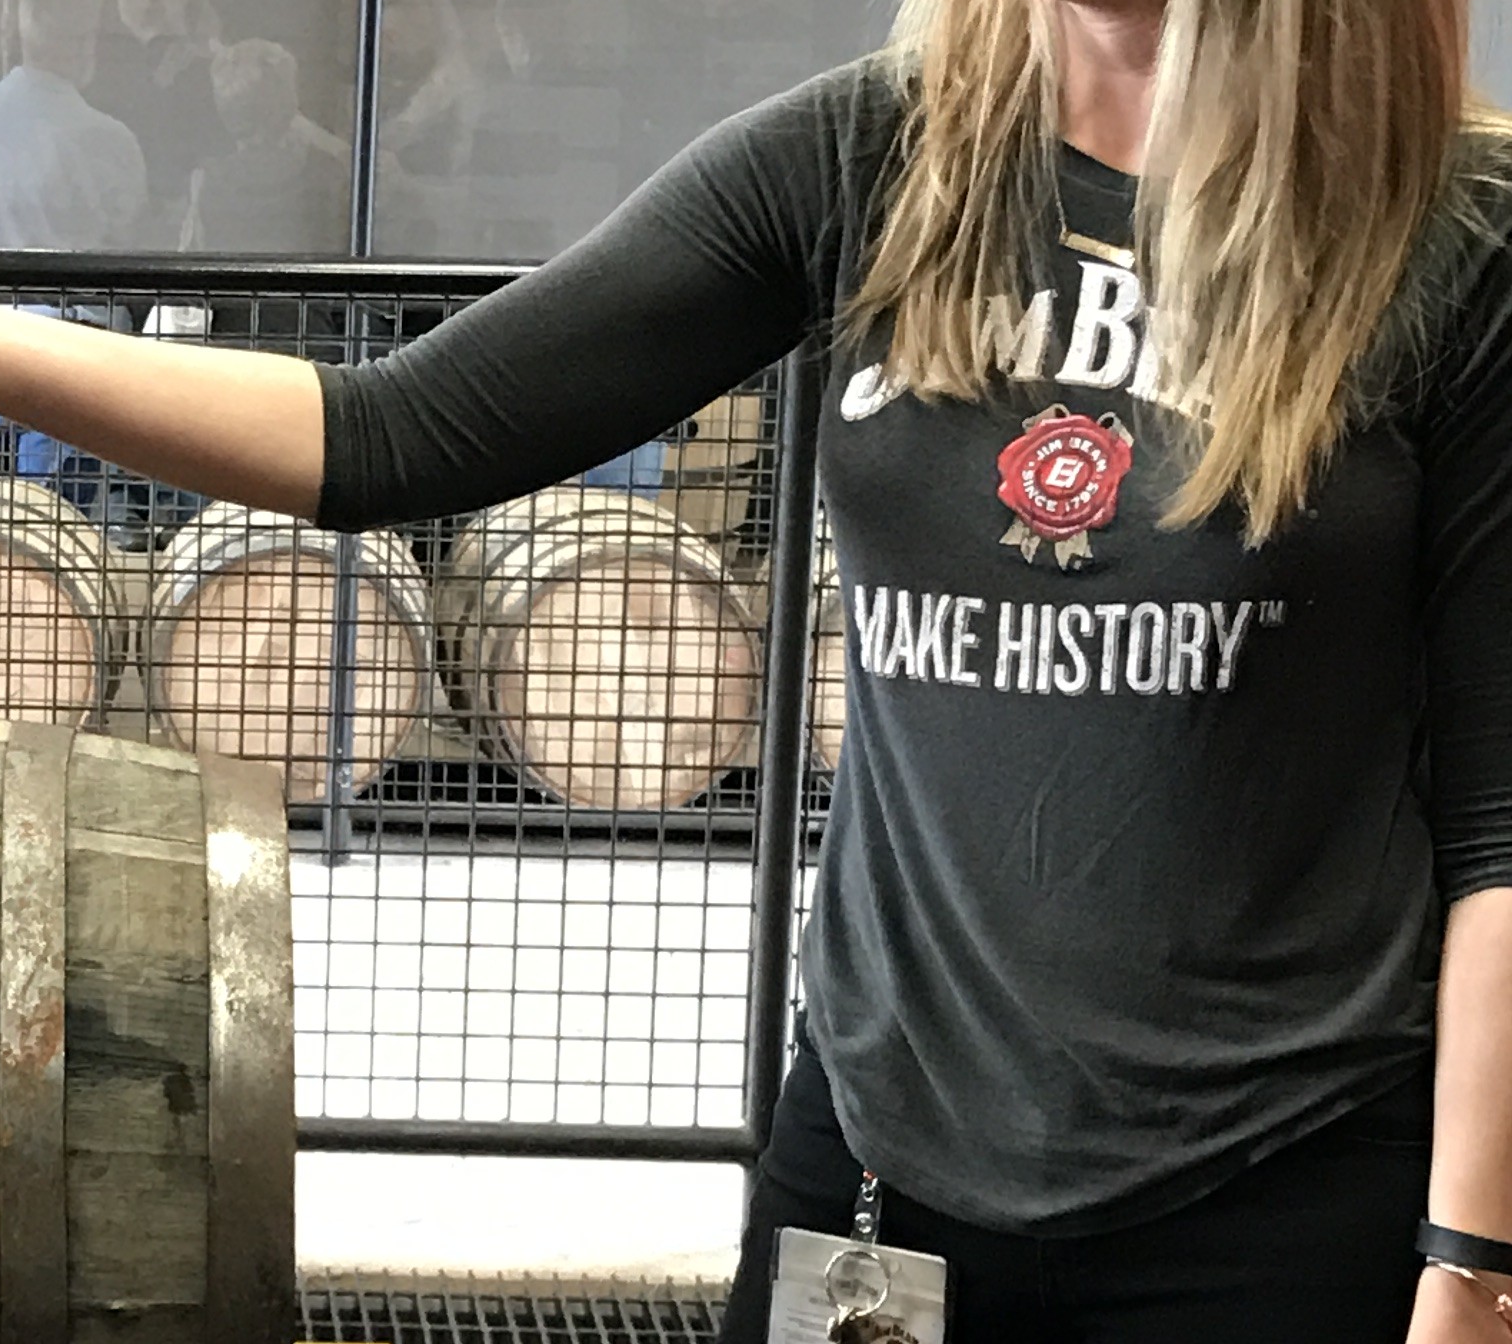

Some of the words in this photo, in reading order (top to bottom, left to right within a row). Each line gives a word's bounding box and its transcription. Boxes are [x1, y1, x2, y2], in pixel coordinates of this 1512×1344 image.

[840, 288, 1058, 423] JM
[1021, 469, 1059, 513] SINCE
[1064, 481, 1100, 513] 1795
[1036, 438, 1063, 461] JIM
[1068, 436, 1108, 474] BEAM
[853, 584, 986, 689] MAKE
